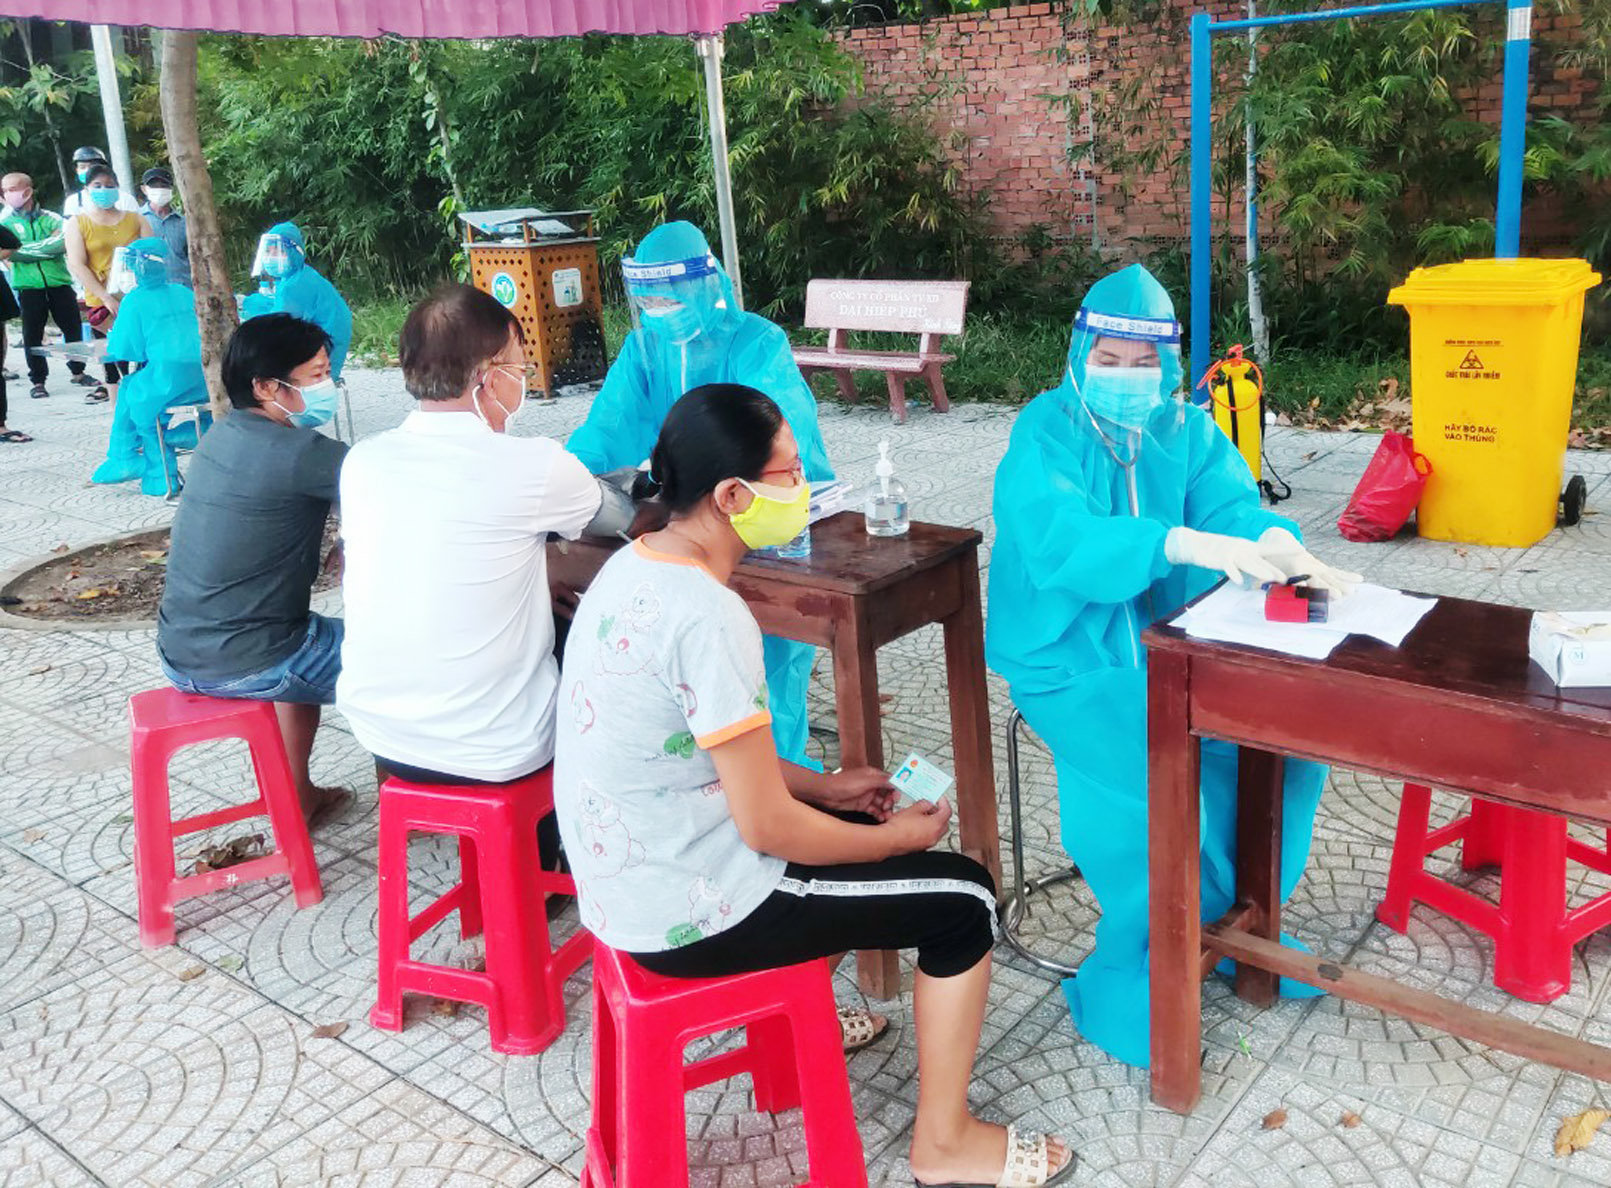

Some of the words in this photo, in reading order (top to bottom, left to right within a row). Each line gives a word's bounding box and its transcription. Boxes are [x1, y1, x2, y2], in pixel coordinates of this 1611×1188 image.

[1096, 316, 1123, 330] Face
[1128, 320, 1163, 334] Shield
[1444, 423, 1461, 431] HÃY
[1478, 424, 1498, 434] RÁC
[1464, 433, 1495, 443] THÙNG
